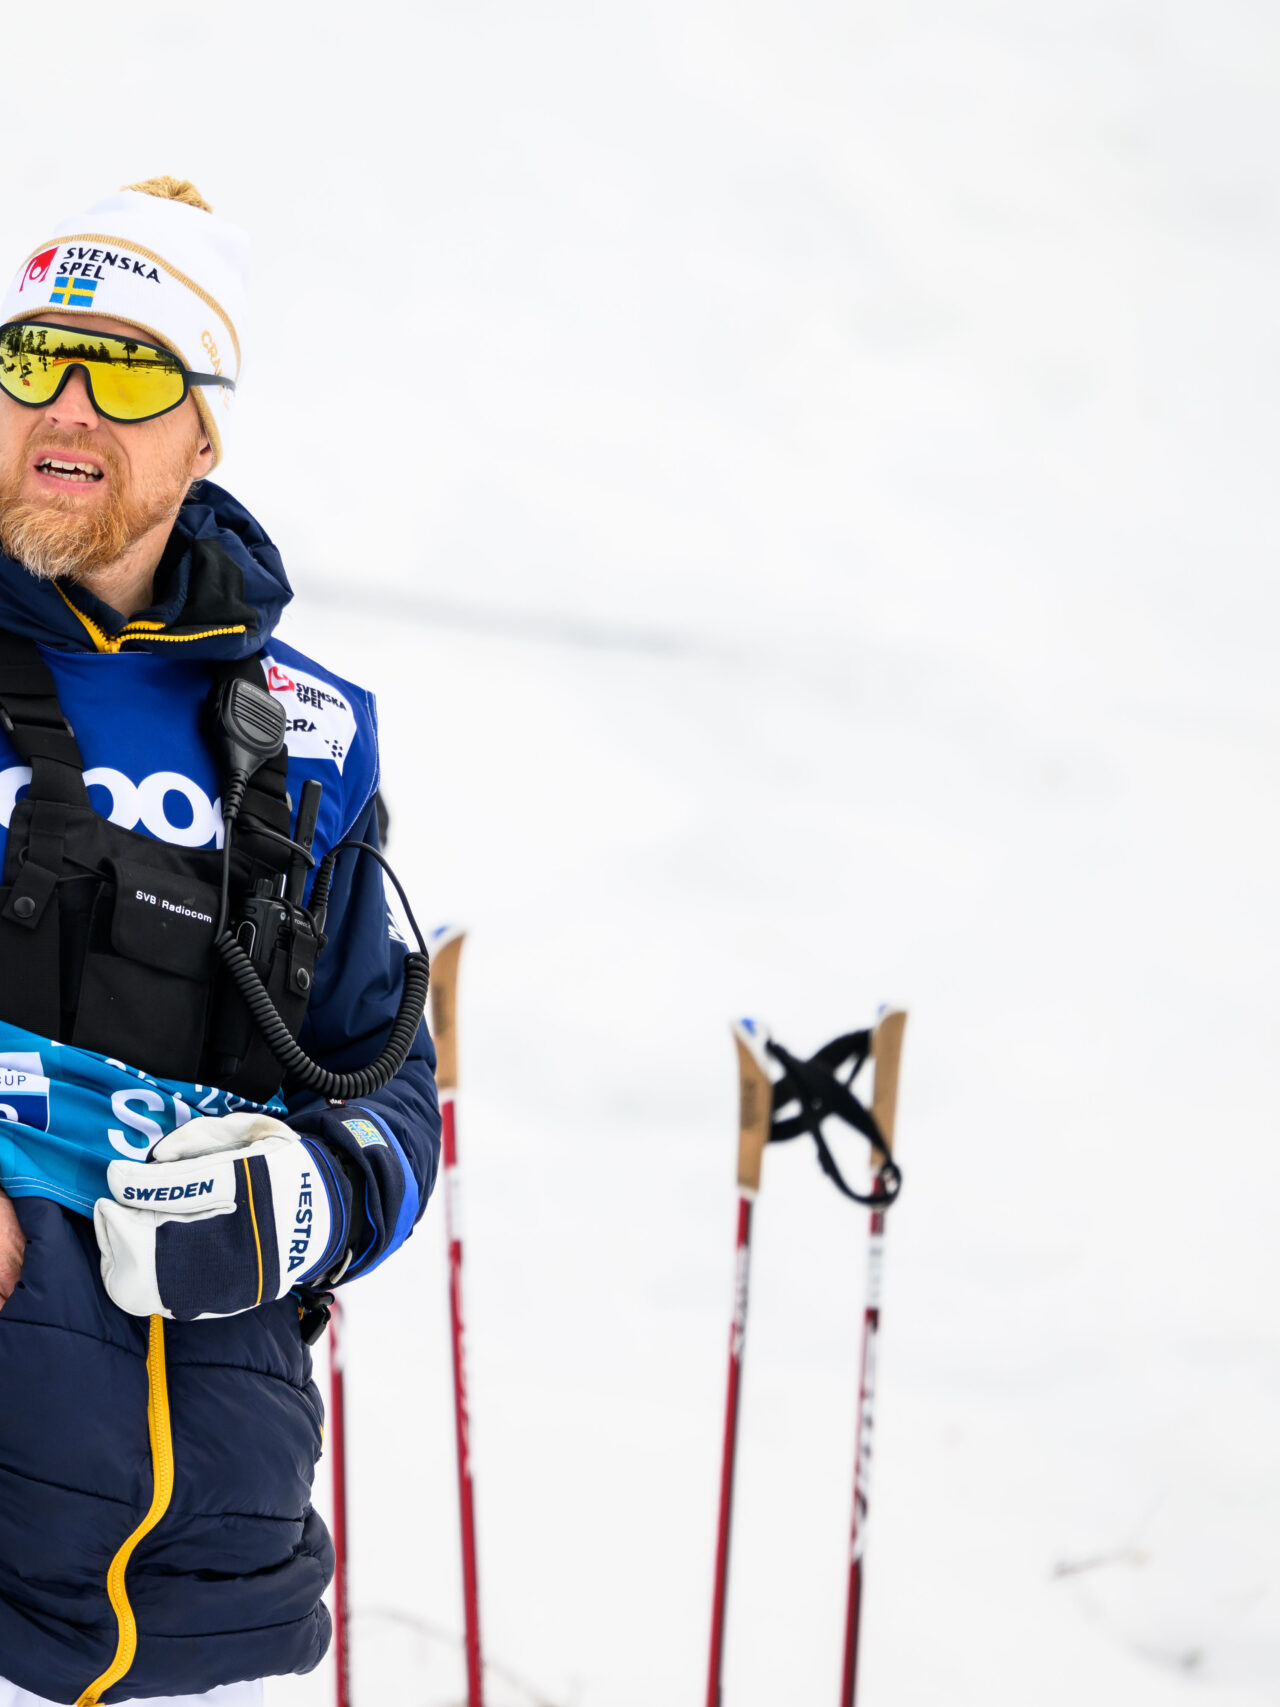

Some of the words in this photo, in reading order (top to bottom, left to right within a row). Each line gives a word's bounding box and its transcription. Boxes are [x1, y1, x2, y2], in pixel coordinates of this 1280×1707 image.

[56, 261, 105, 280] SPEL
[63, 247, 161, 283] SVENSKA
[296, 683, 347, 711] SVENSKA
[296, 692, 324, 710] SPEL
[285, 718, 318, 732] CRA
[135, 890, 157, 905] SVB
[161, 900, 213, 923] Radiocom
[123, 1179, 214, 1201] SWEDEN
[287, 1172, 313, 1273] HESTRA
